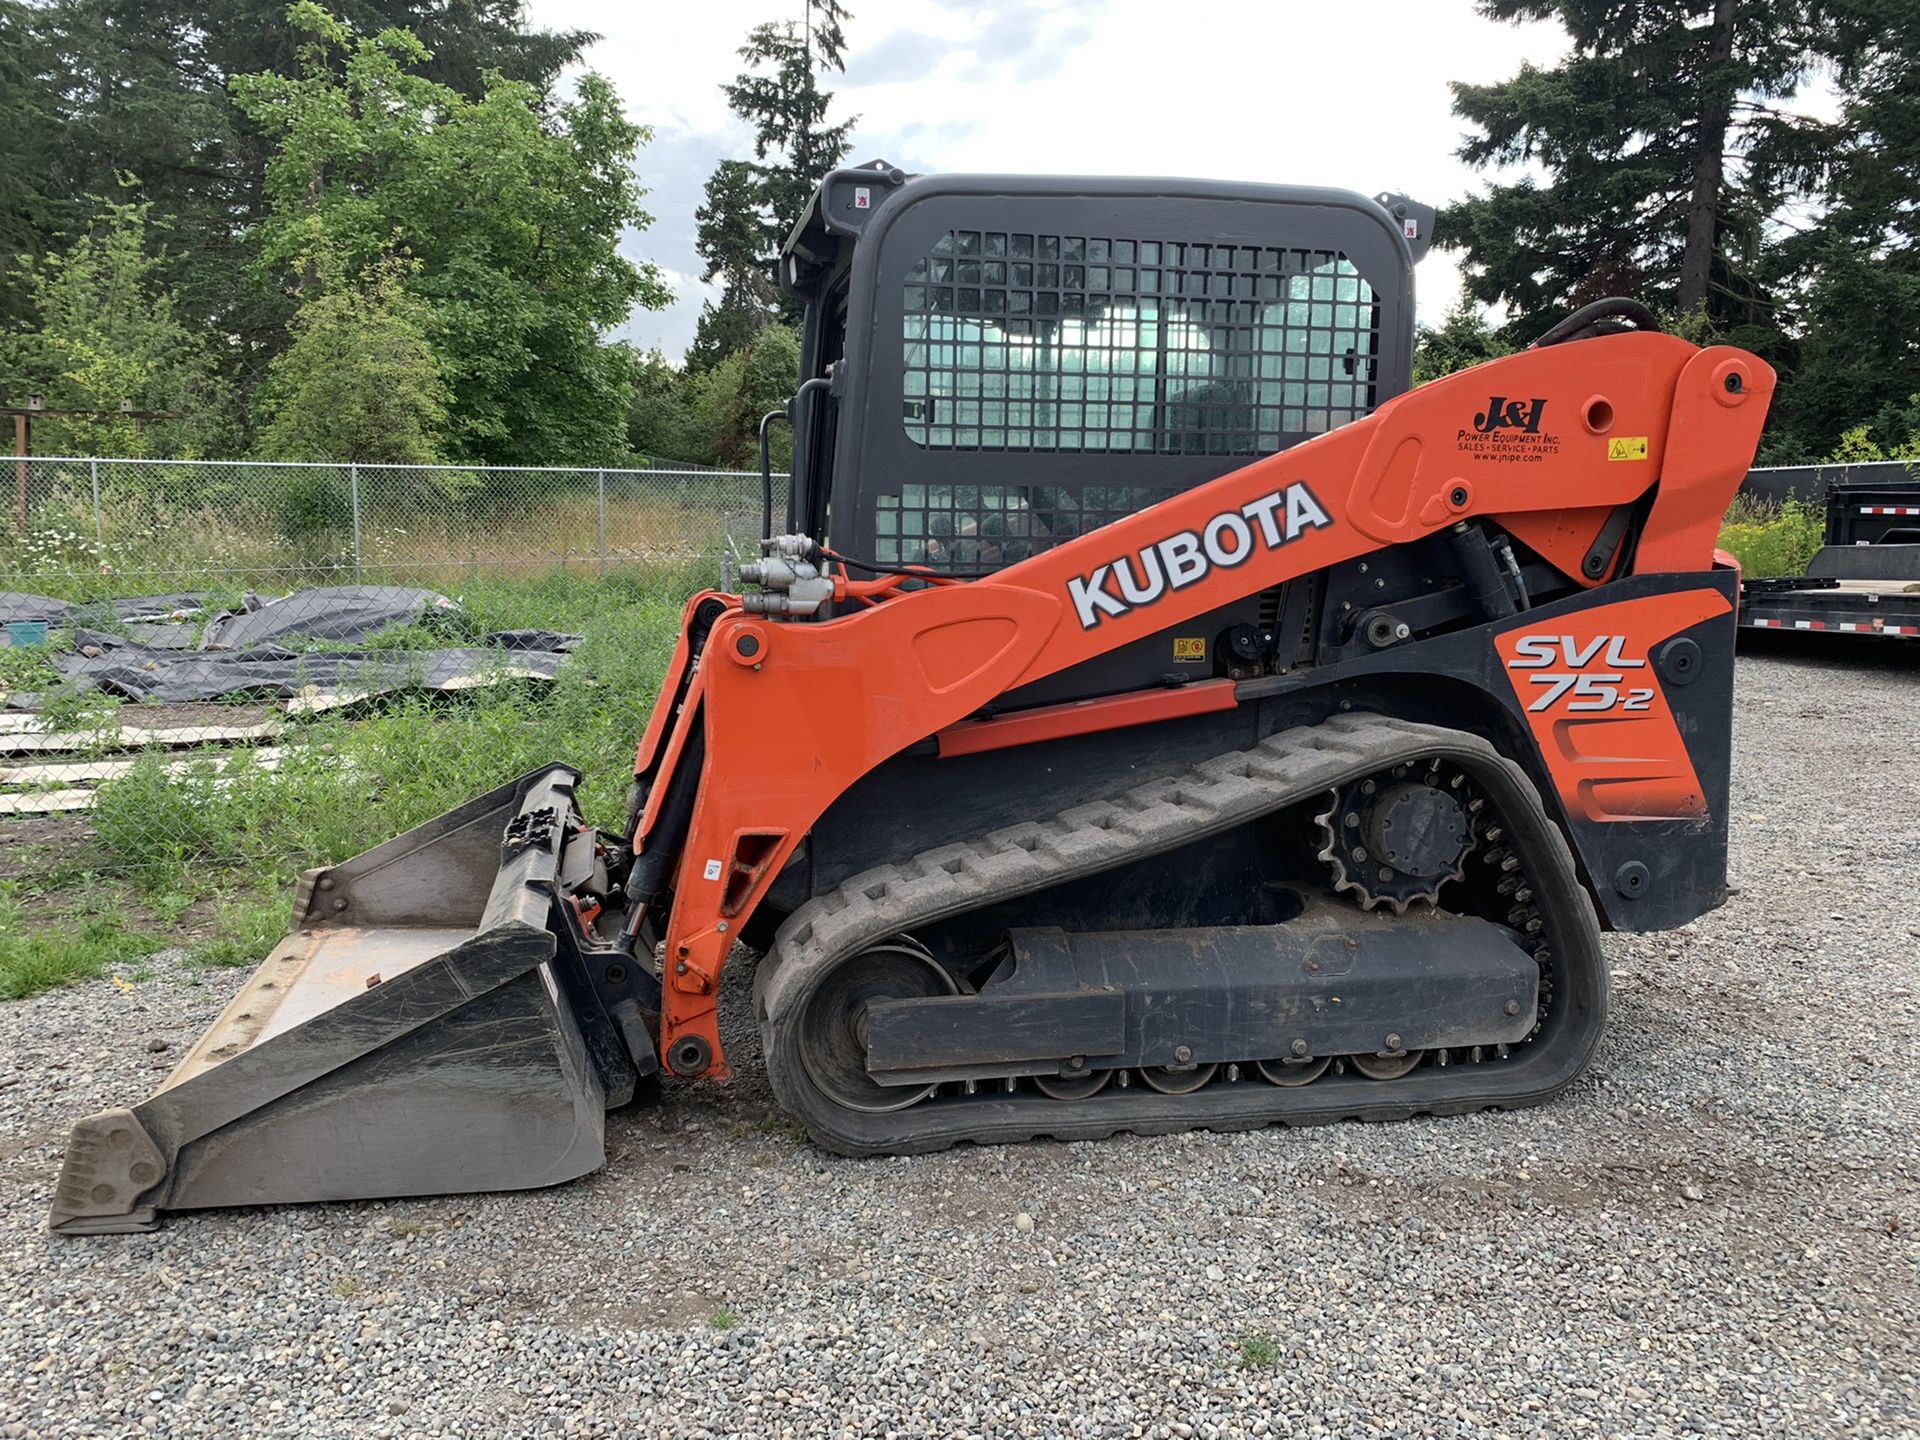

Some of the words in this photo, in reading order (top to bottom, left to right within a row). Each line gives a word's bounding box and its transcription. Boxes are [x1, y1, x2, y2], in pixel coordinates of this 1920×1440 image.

[1474, 396, 1548, 433] J&I
[1457, 443, 1485, 451] SALES
[1491, 444, 1525, 453] SERVICE
[1533, 445, 1559, 454] PARTS
[1474, 453, 1543, 463] www.jnipe.com
[1066, 481, 1333, 629] KUBOTA
[1508, 635, 1646, 669] SVL
